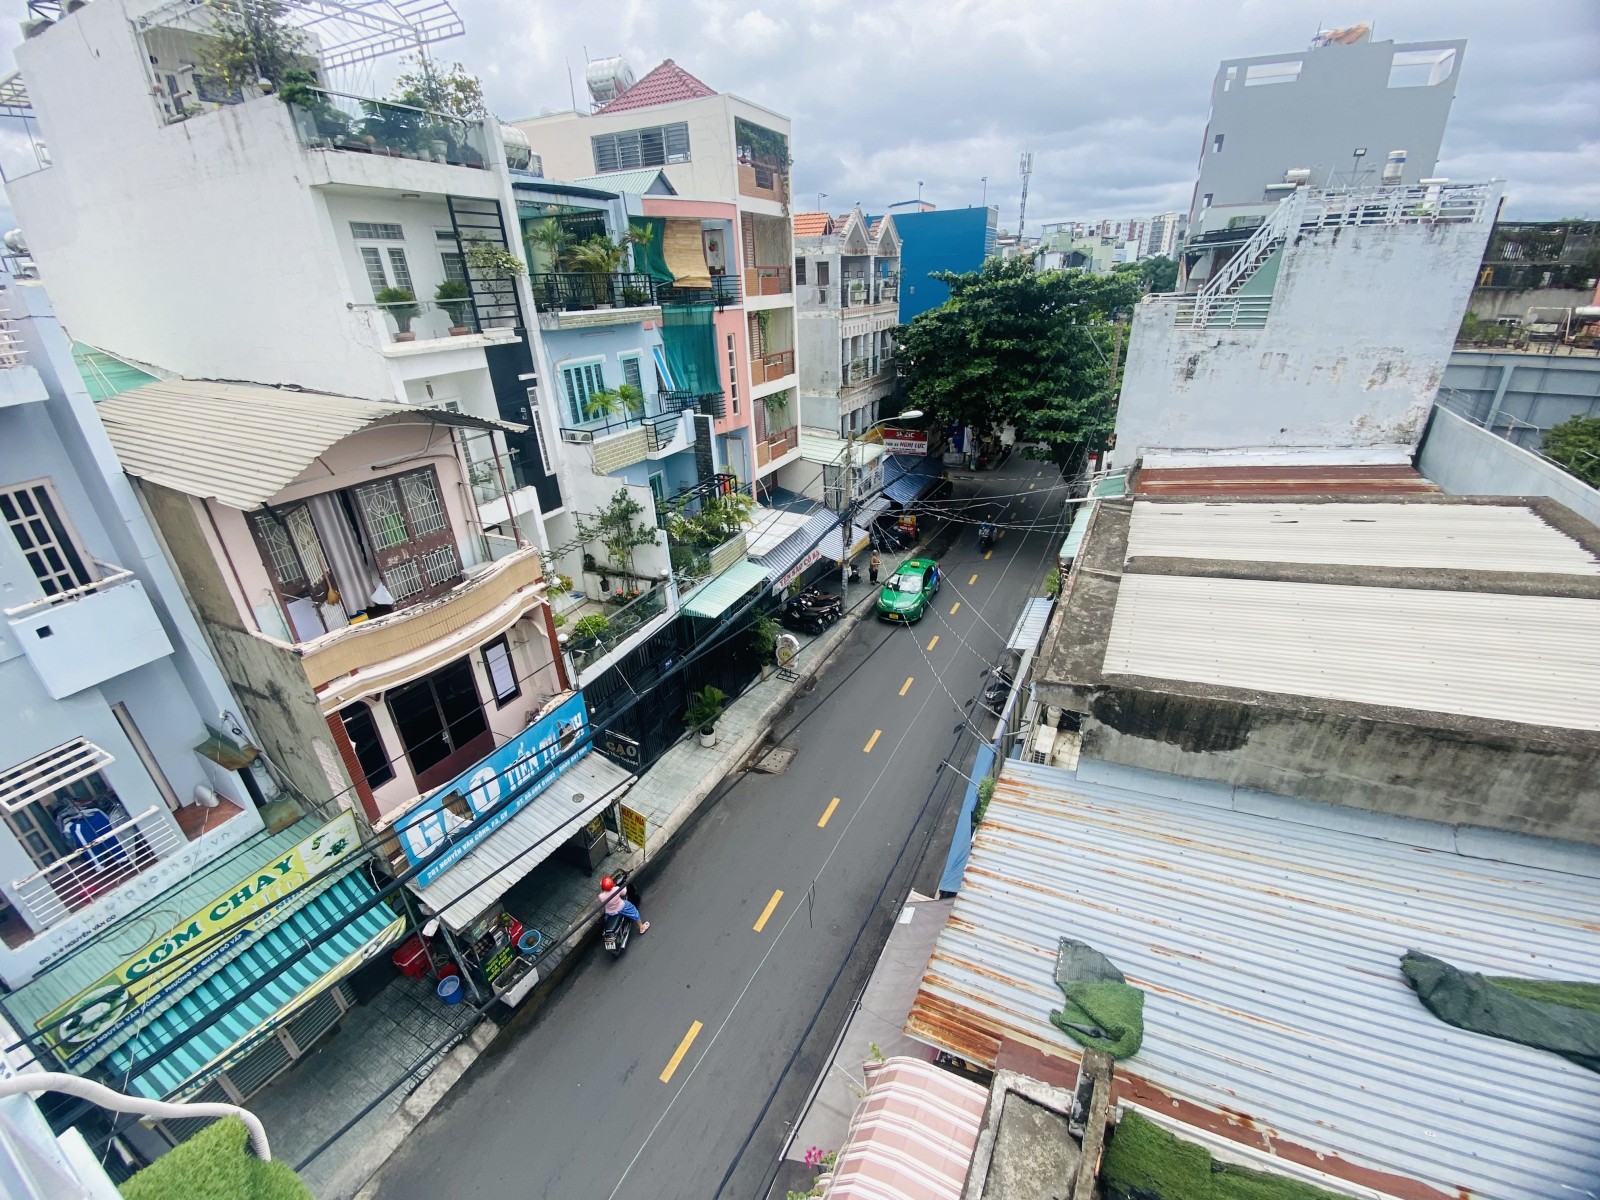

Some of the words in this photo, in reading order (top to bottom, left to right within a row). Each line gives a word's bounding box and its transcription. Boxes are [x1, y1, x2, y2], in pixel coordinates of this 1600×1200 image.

[125, 919, 203, 981] CƠM
[209, 854, 294, 921] CHAY
[96, 1020, 126, 1043] NGUYỄN
[124, 1008, 140, 1023] VĂN
[229, 933, 243, 945] VẤP
